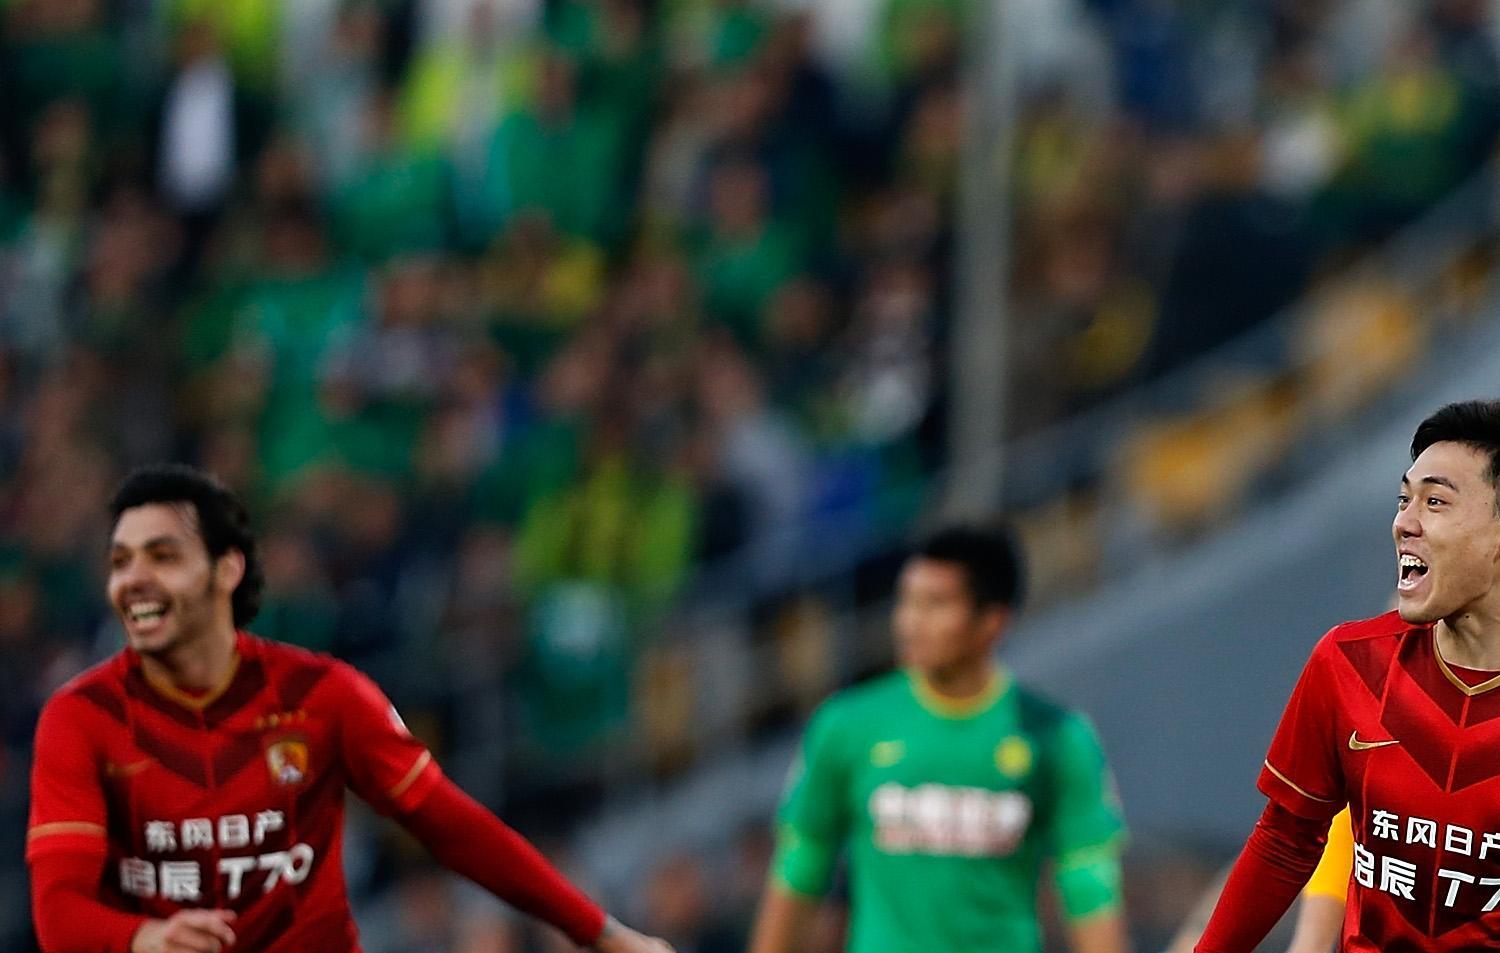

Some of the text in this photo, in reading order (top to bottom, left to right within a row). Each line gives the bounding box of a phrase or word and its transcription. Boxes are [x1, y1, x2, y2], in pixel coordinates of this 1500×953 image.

[145, 809, 285, 852] 东风日产
[217, 842, 314, 899] T70
[1354, 841, 1417, 901] 启辰
